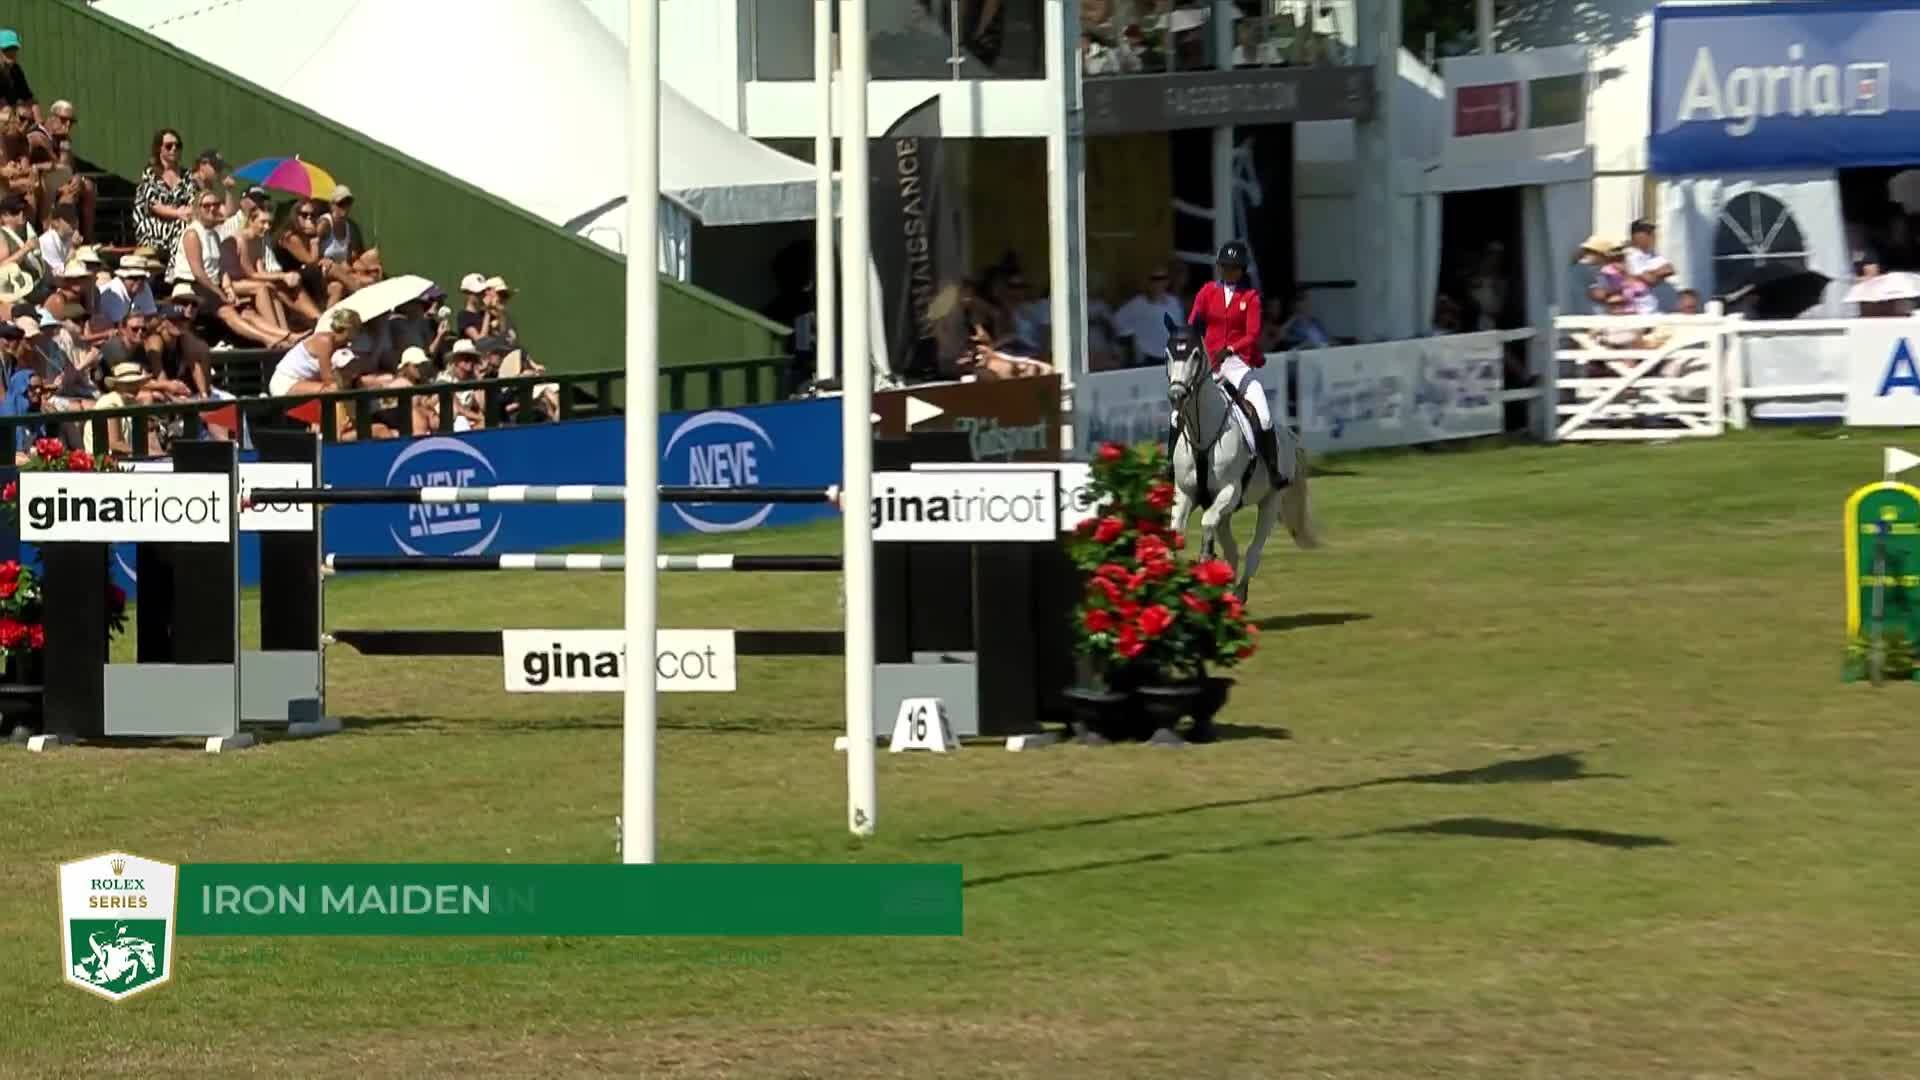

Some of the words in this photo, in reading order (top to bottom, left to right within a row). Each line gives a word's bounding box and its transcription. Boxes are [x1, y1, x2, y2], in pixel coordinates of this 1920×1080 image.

[1677, 44, 1841, 136] Agria
[896, 137, 933, 340] NAISSANCE
[689, 441, 758, 487] AVEVE
[28, 487, 221, 530] ginatricot
[523, 643, 718, 686] ginacot
[908, 705, 928, 742] 16
